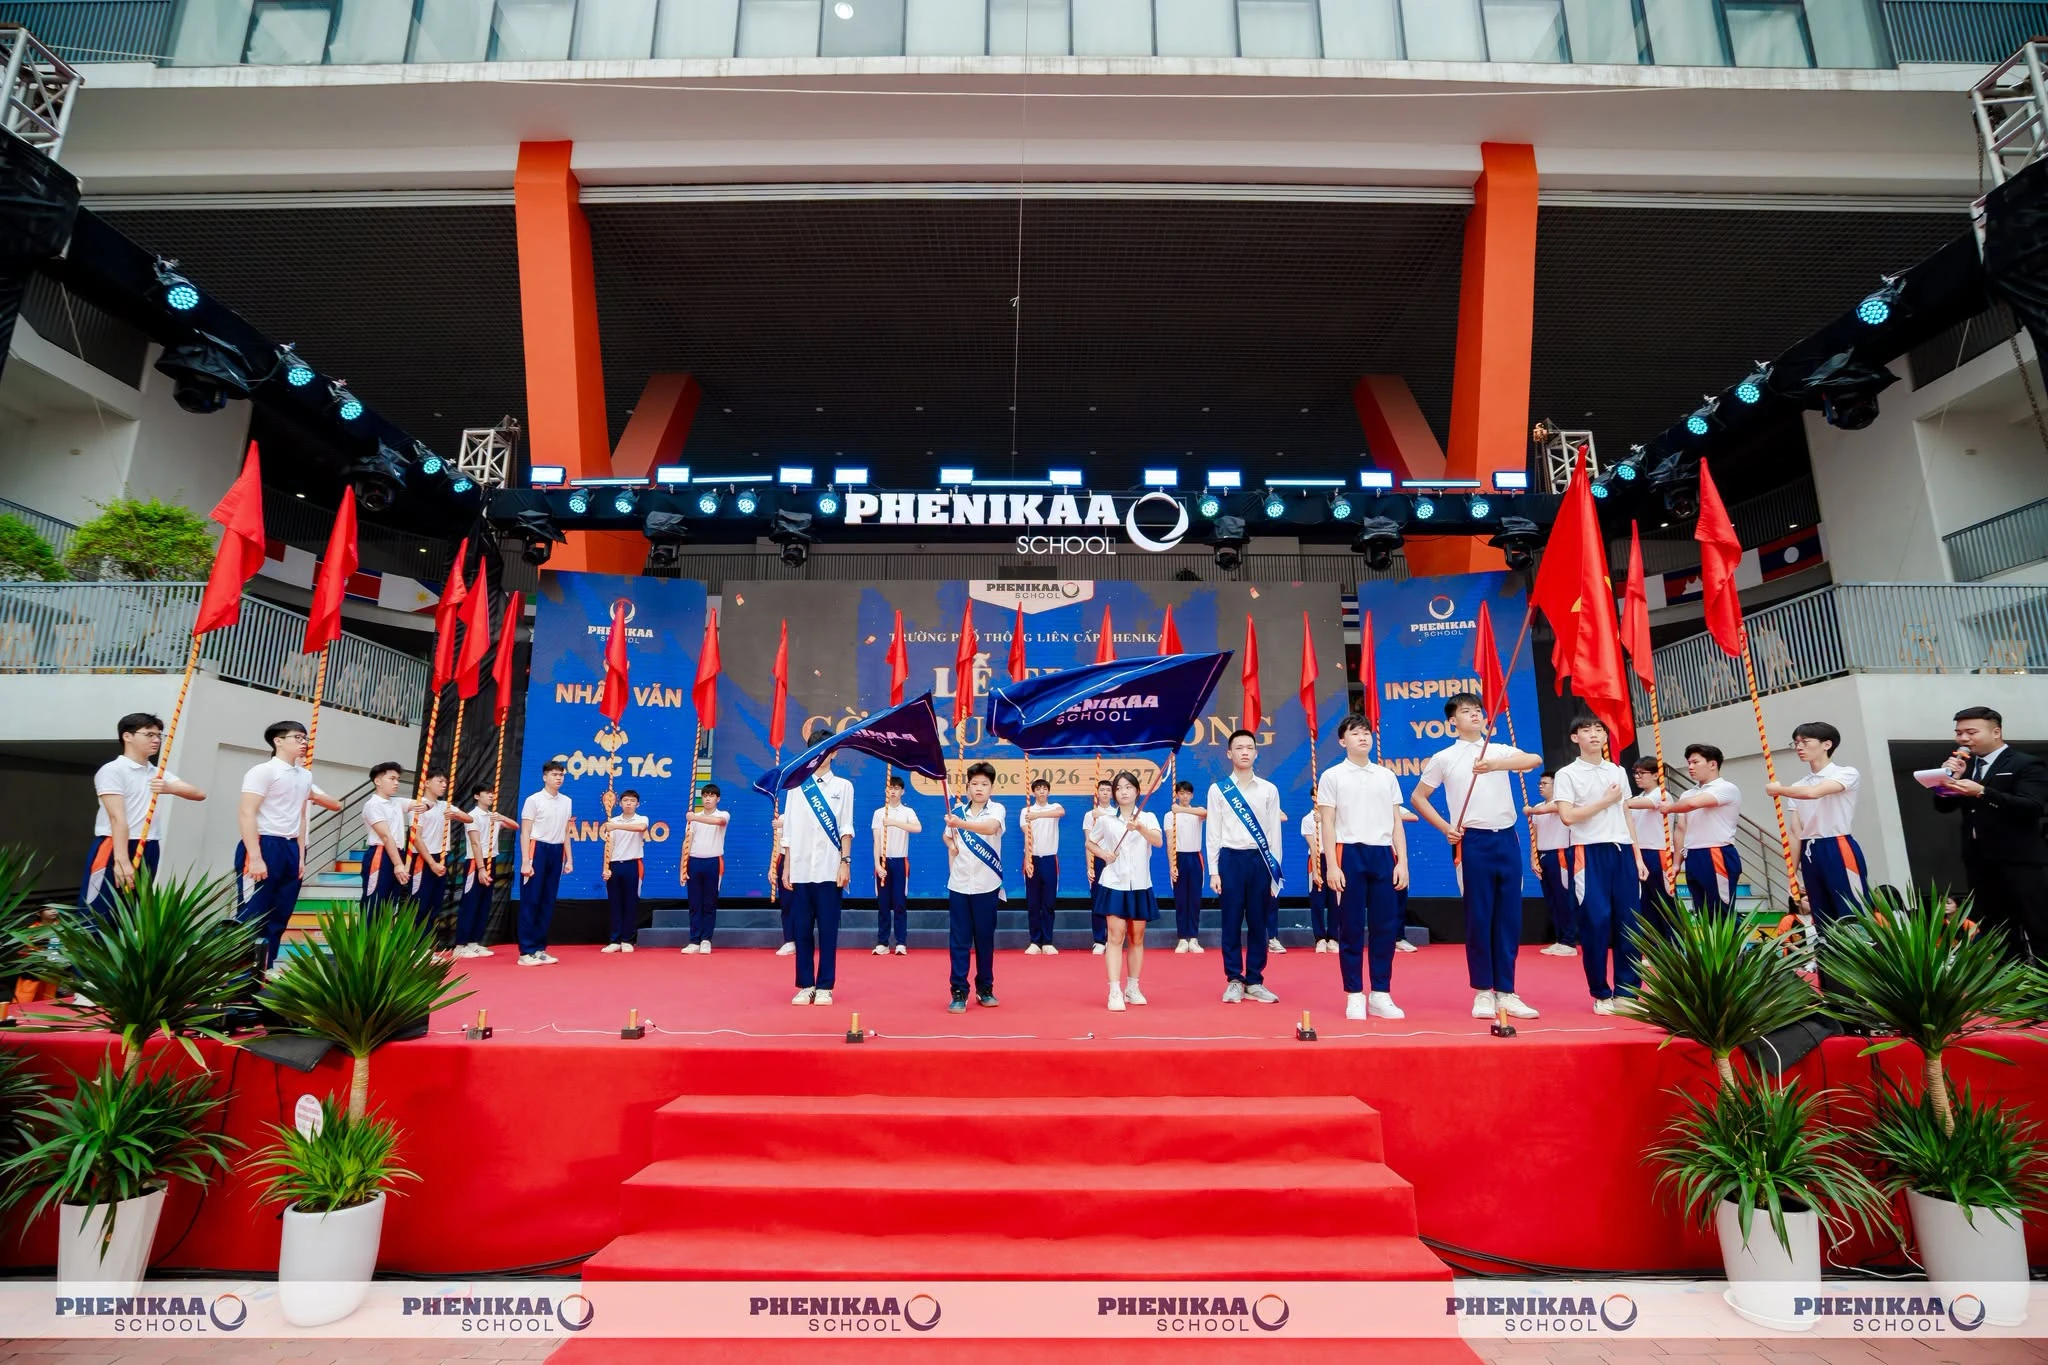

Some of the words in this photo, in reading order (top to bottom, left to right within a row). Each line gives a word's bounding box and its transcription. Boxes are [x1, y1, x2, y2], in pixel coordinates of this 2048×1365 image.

[844, 493, 1120, 525] PHENIKAA
[1016, 536, 1116, 555] SCHOOL
[986, 583, 1060, 592] PHENIKAA
[984, 630, 1033, 642] THÔG
[1037, 630, 1066, 642] LIÊN
[1074, 628, 1100, 642] CẤP
[1411, 620, 1476, 632] PHENIKAA
[1424, 629, 1463, 638] SCHOOL
[1385, 678, 1483, 700] INSPIRIN
[1056, 711, 1132, 725] SCHOOL
[628, 753, 673, 778] TÁC
[1030, 768, 1080, 785] 2026
[811, 795, 824, 813] HỌC
[820, 811, 834, 831] SINH
[1231, 796, 1246, 814] HỌC
[1242, 813, 1257, 832] SINH
[962, 830, 976, 846] HỌC
[973, 843, 993, 861] SINH
